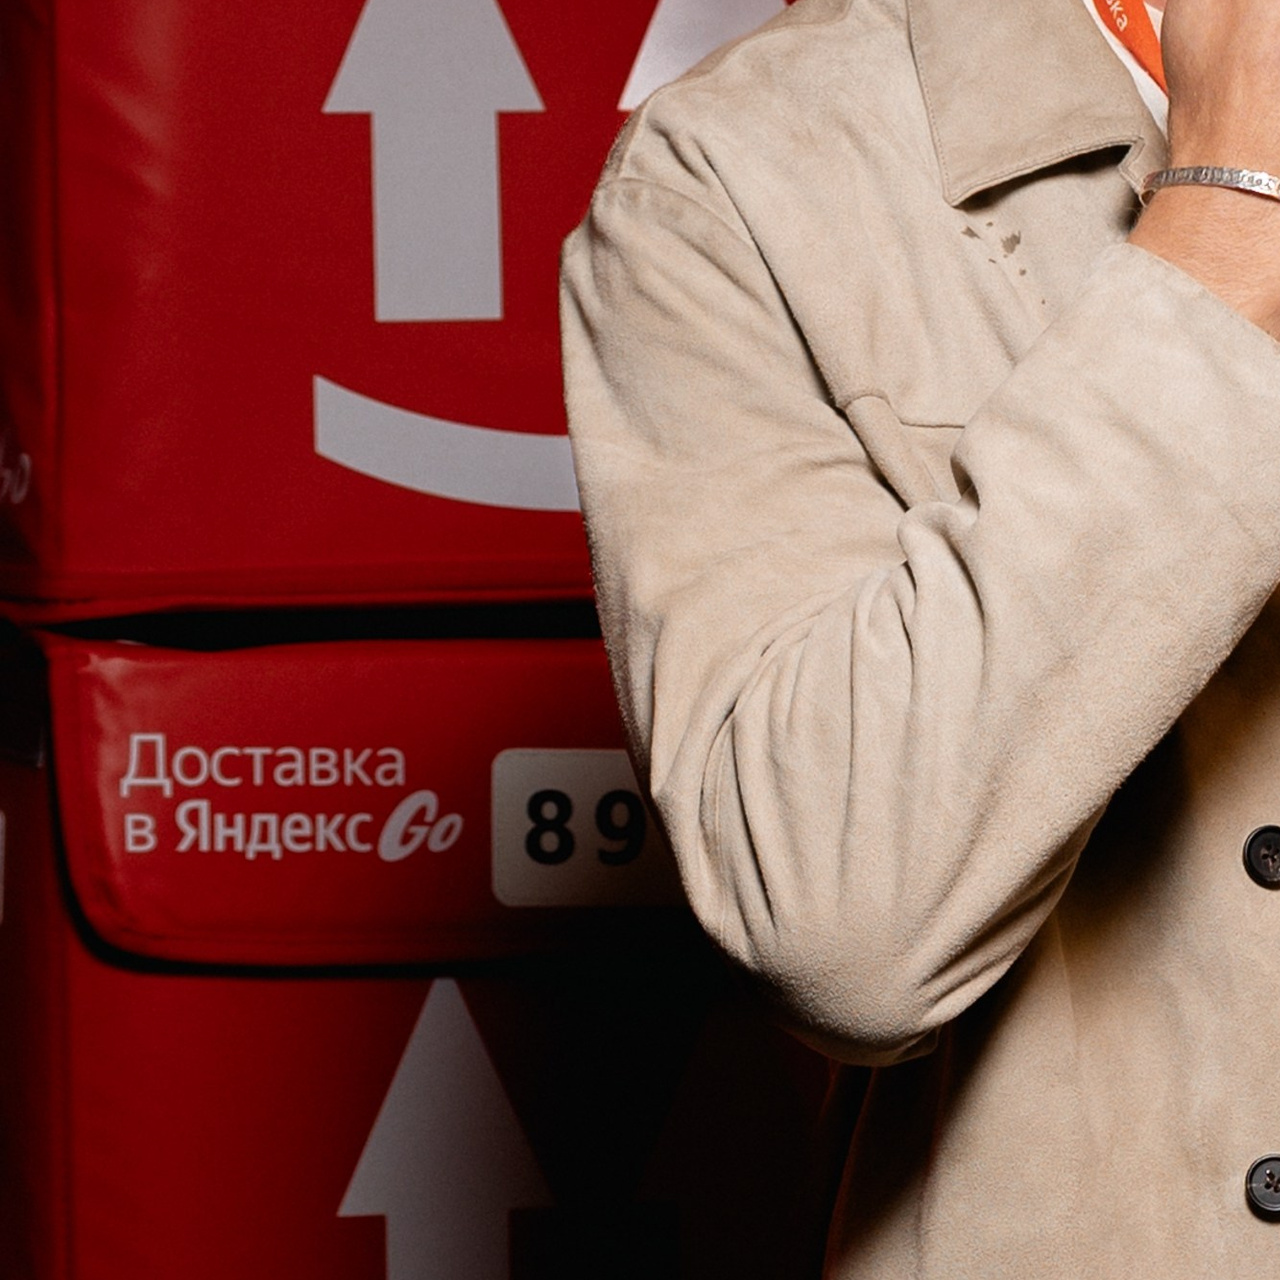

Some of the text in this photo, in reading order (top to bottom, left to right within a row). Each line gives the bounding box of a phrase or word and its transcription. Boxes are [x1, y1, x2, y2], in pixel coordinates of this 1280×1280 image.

[119, 732, 407, 798] Доставка
[123, 787, 465, 863] в Яндекс Go
